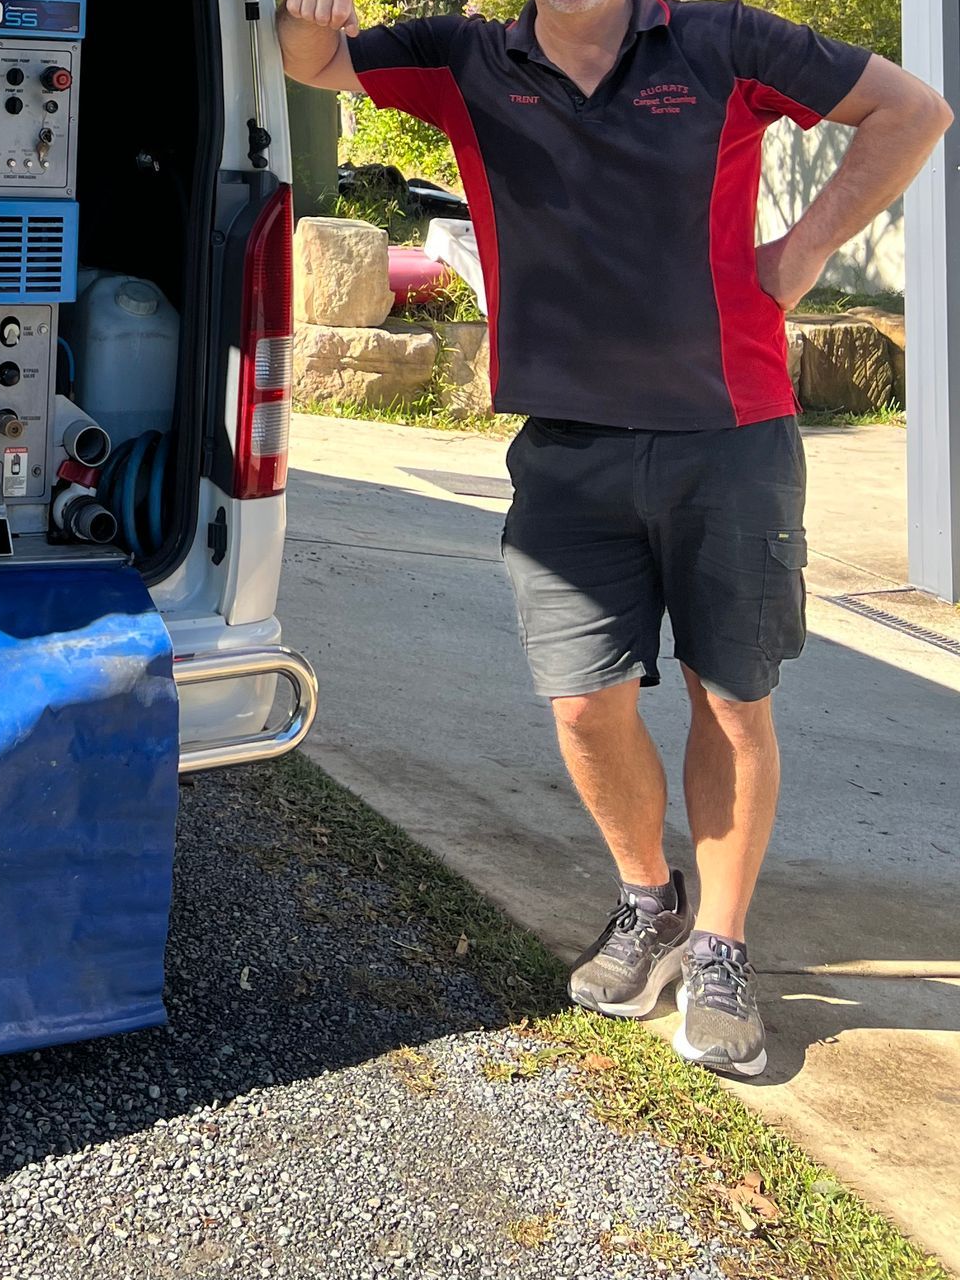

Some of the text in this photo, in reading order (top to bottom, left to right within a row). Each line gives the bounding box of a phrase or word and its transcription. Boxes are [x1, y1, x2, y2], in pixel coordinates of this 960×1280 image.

[640, 84, 689, 97] RUGRATS
[509, 94, 540, 104] TRENT
[633, 96, 697, 106] Carpet Cleaning
[651, 106, 680, 114] Service
